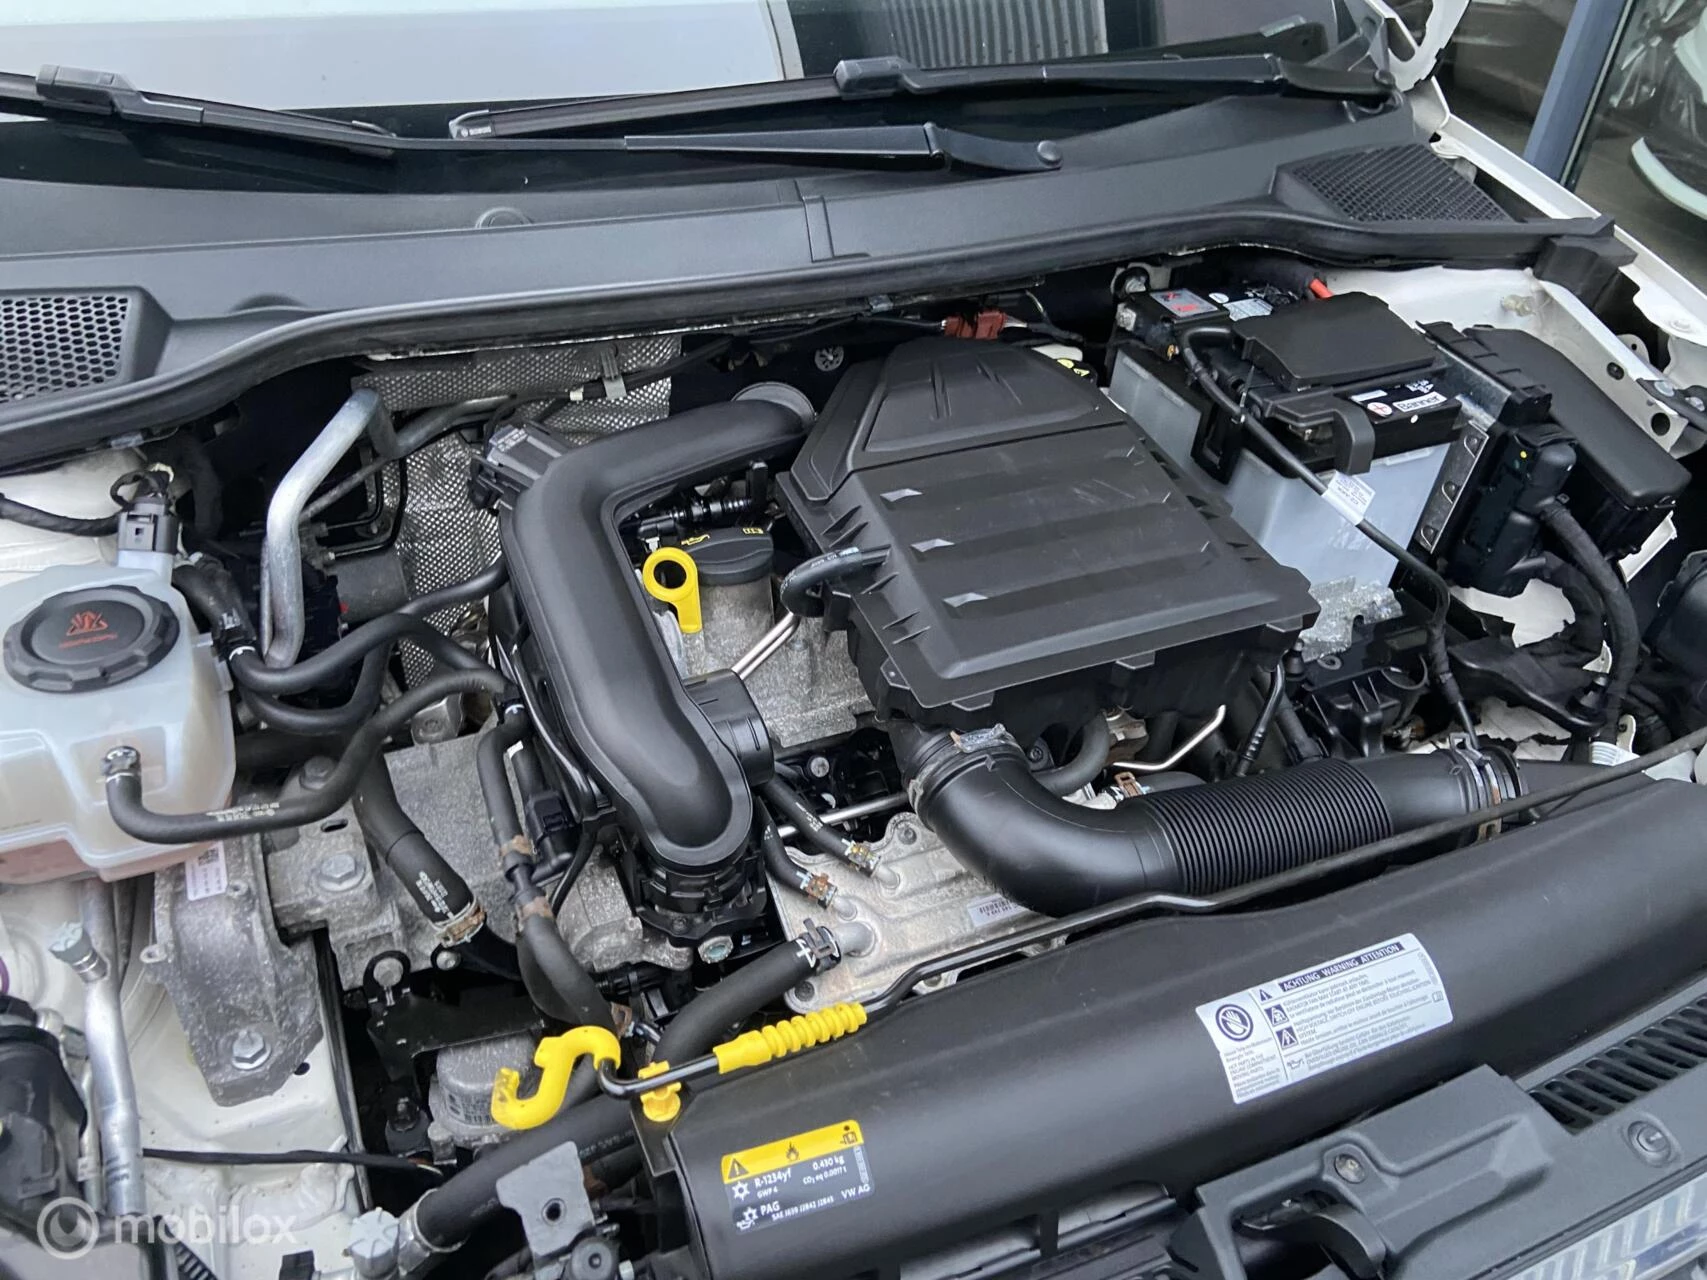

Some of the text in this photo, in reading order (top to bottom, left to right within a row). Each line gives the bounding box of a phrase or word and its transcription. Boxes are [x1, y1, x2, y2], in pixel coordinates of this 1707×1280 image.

[1397, 396, 1440, 410] Banner
[1282, 944, 1400, 991] ACHTUNG WARNING ATTENTION
[833, 1155, 845, 1165] kg
[754, 1168, 792, 1188] R-1234yf
[840, 1183, 871, 1200] VW AG
[760, 1201, 780, 1216] PAG
